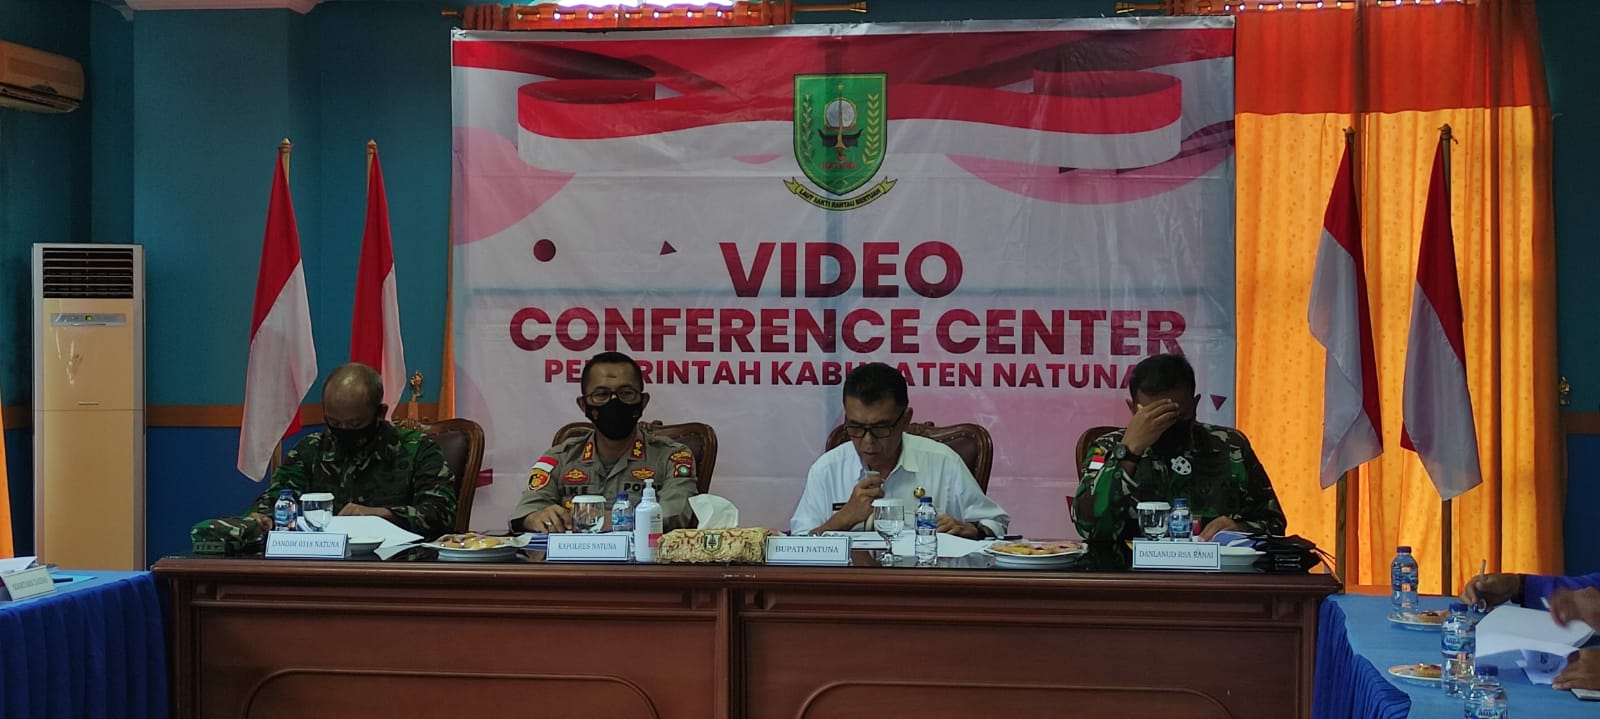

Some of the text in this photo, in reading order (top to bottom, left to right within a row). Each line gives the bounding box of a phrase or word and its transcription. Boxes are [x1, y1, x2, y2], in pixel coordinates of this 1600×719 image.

[719, 241, 963, 298] VIDEO
[509, 307, 1186, 356] CONFERENCE CENTER
[545, 359, 760, 386] PERINTAH
[771, 361, 982, 387] KABATEN
[558, 542, 591, 550] KAPOLRES
[775, 545, 839, 553] BUPATI NATUNA
[1139, 550, 1177, 558] DANLANUD
[1193, 551, 1214, 559] RANAI
